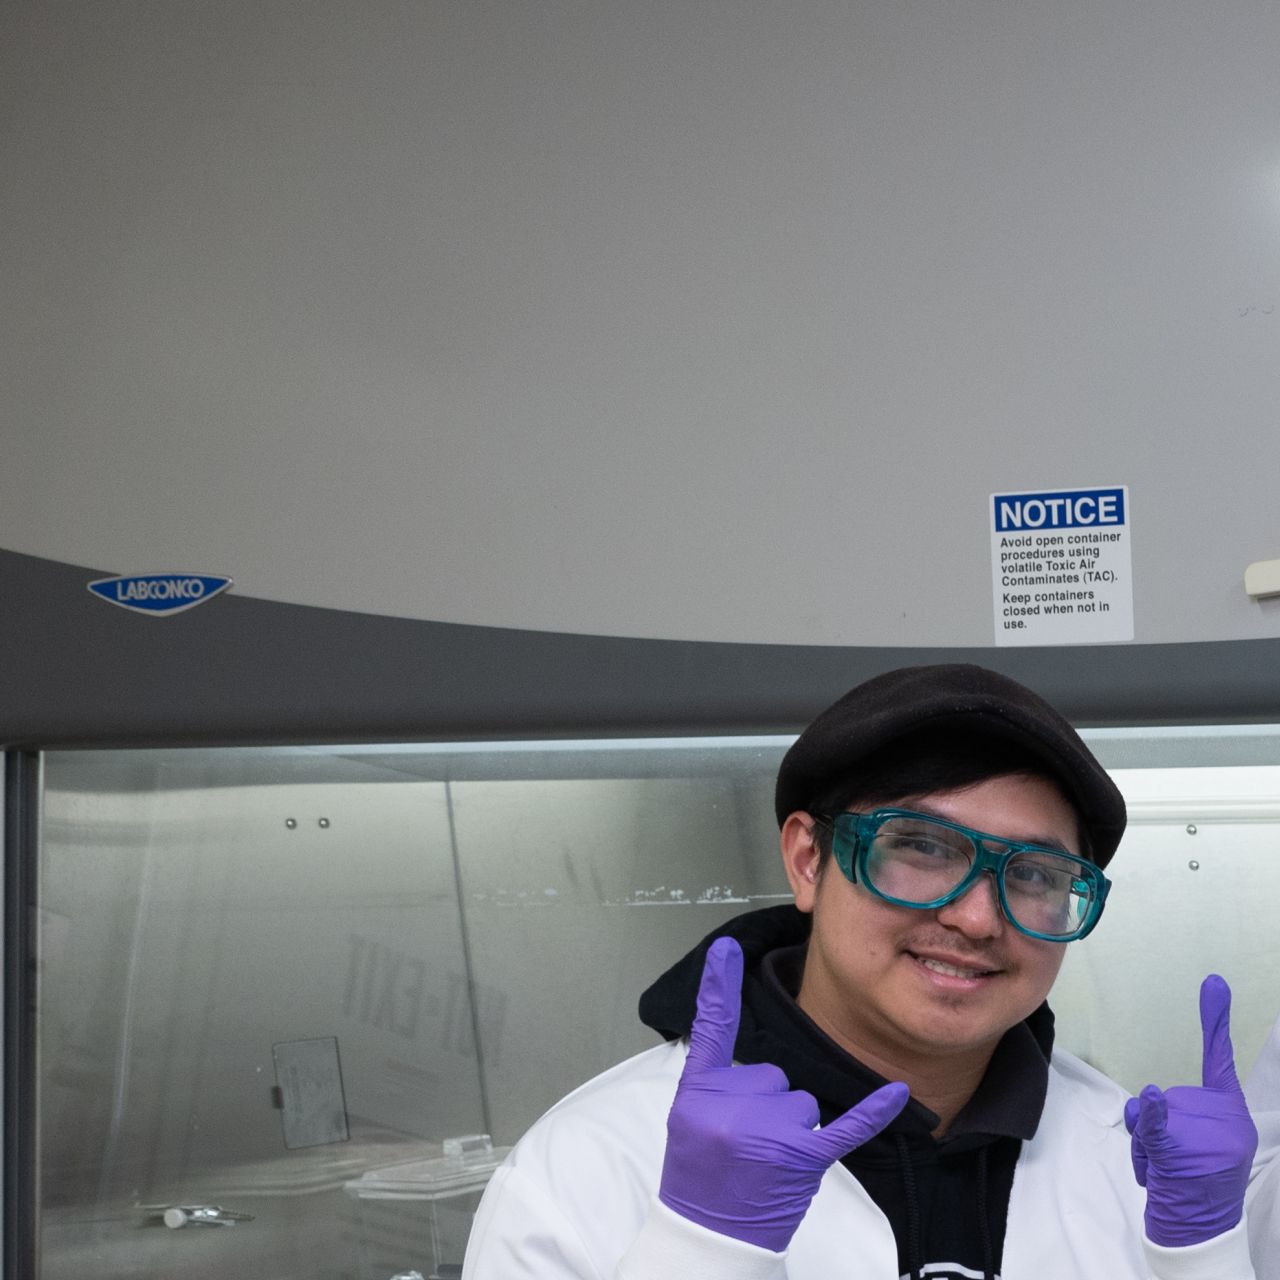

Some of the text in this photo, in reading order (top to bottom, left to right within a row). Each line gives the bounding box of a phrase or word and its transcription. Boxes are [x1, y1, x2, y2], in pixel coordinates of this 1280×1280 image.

[1001, 496, 1118, 528] NOTICE
[1001, 532, 1121, 548] Avoid open container
[1001, 546, 1100, 563] procedures using
[1001, 559, 1096, 573] volatile Toxic Air
[1002, 570, 1118, 587] Contaminates (TAC).
[117, 579, 205, 600] LABCONCO
[1002, 590, 1095, 605] Keep containers
[1003, 601, 1110, 616] closed when not in
[1003, 620, 1027, 629] use.
